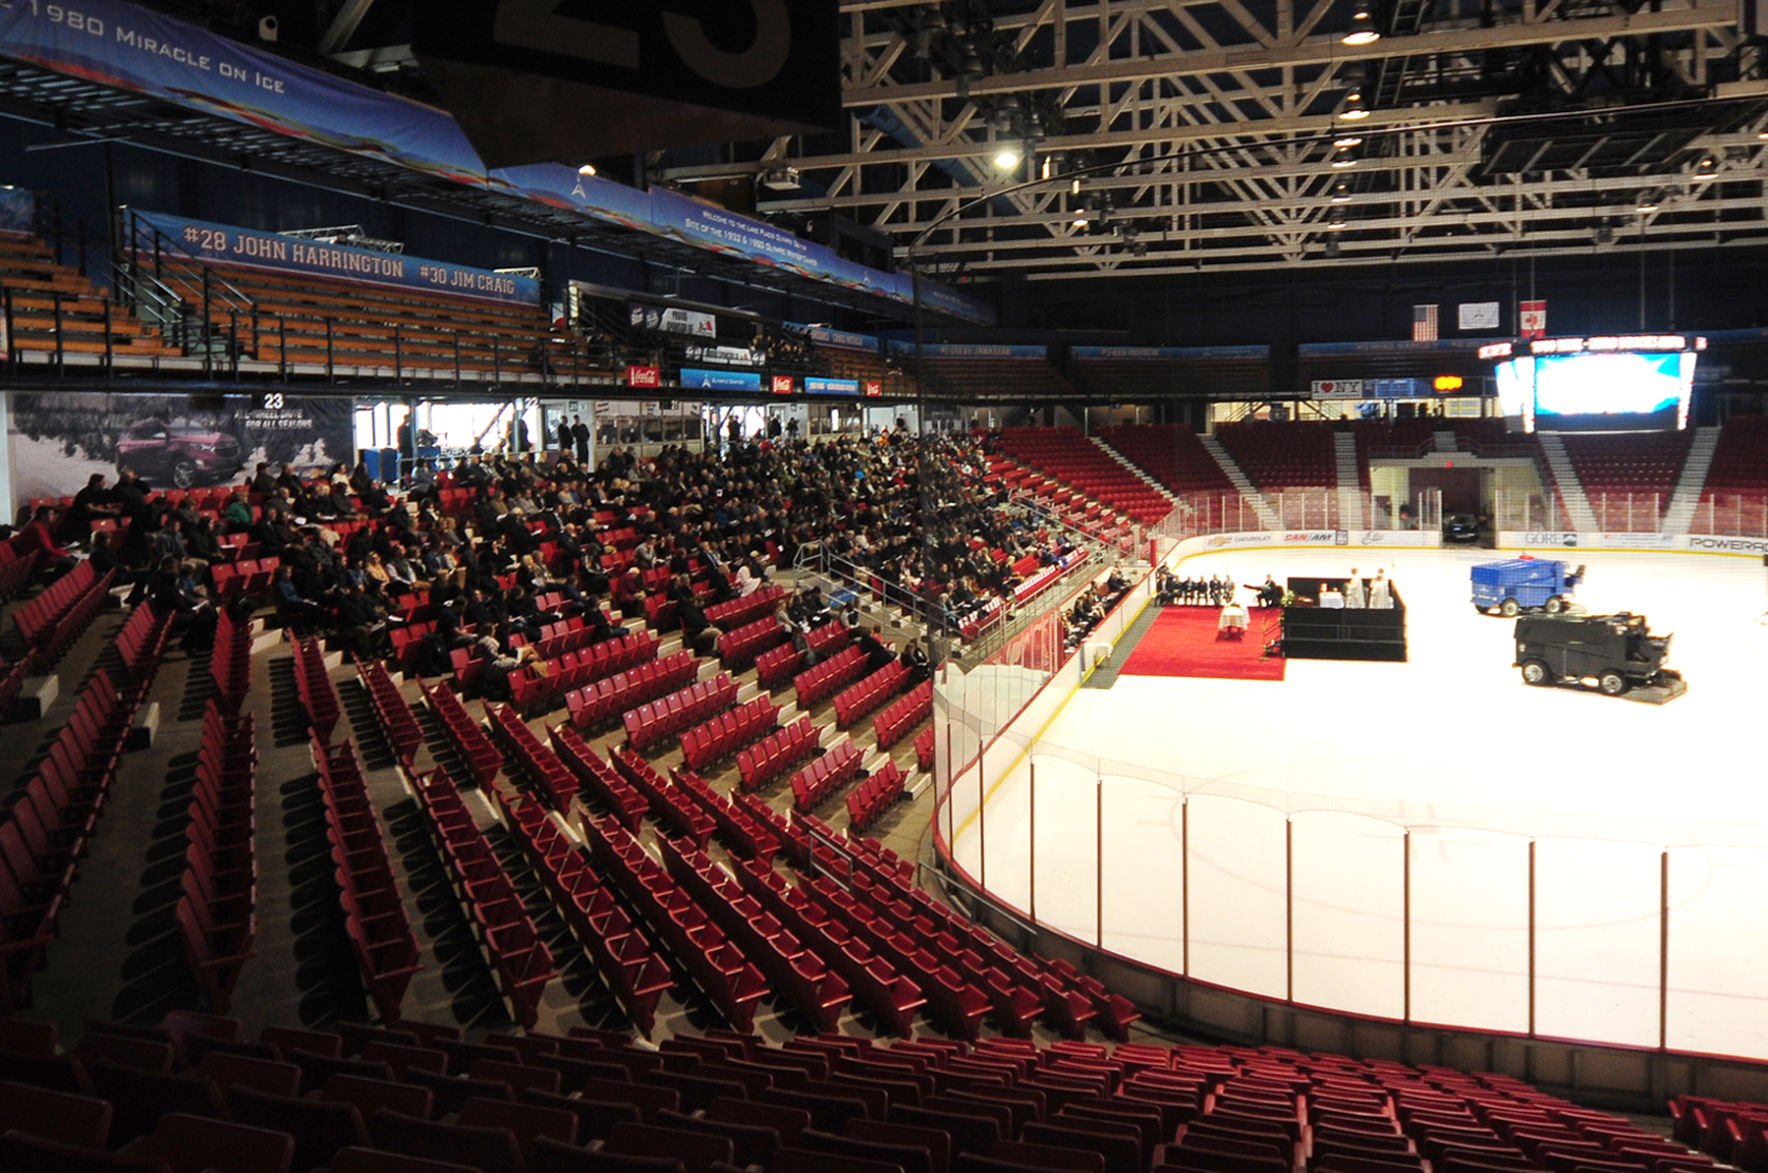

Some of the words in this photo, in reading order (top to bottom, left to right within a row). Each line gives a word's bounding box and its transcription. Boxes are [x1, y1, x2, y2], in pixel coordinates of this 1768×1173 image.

[30, 0, 104, 36] 1980
[184, 225, 226, 251] #28
[233, 235, 287, 261] JOHN
[292, 243, 404, 278] HARRINGTON
[419, 264, 448, 284] #30
[450, 270, 475, 288] JIM
[477, 274, 515, 295] CRAIG
[1313, 382, 1320, 393] I
[264, 392, 284, 409] 23
[1525, 534, 1562, 544] GORE
